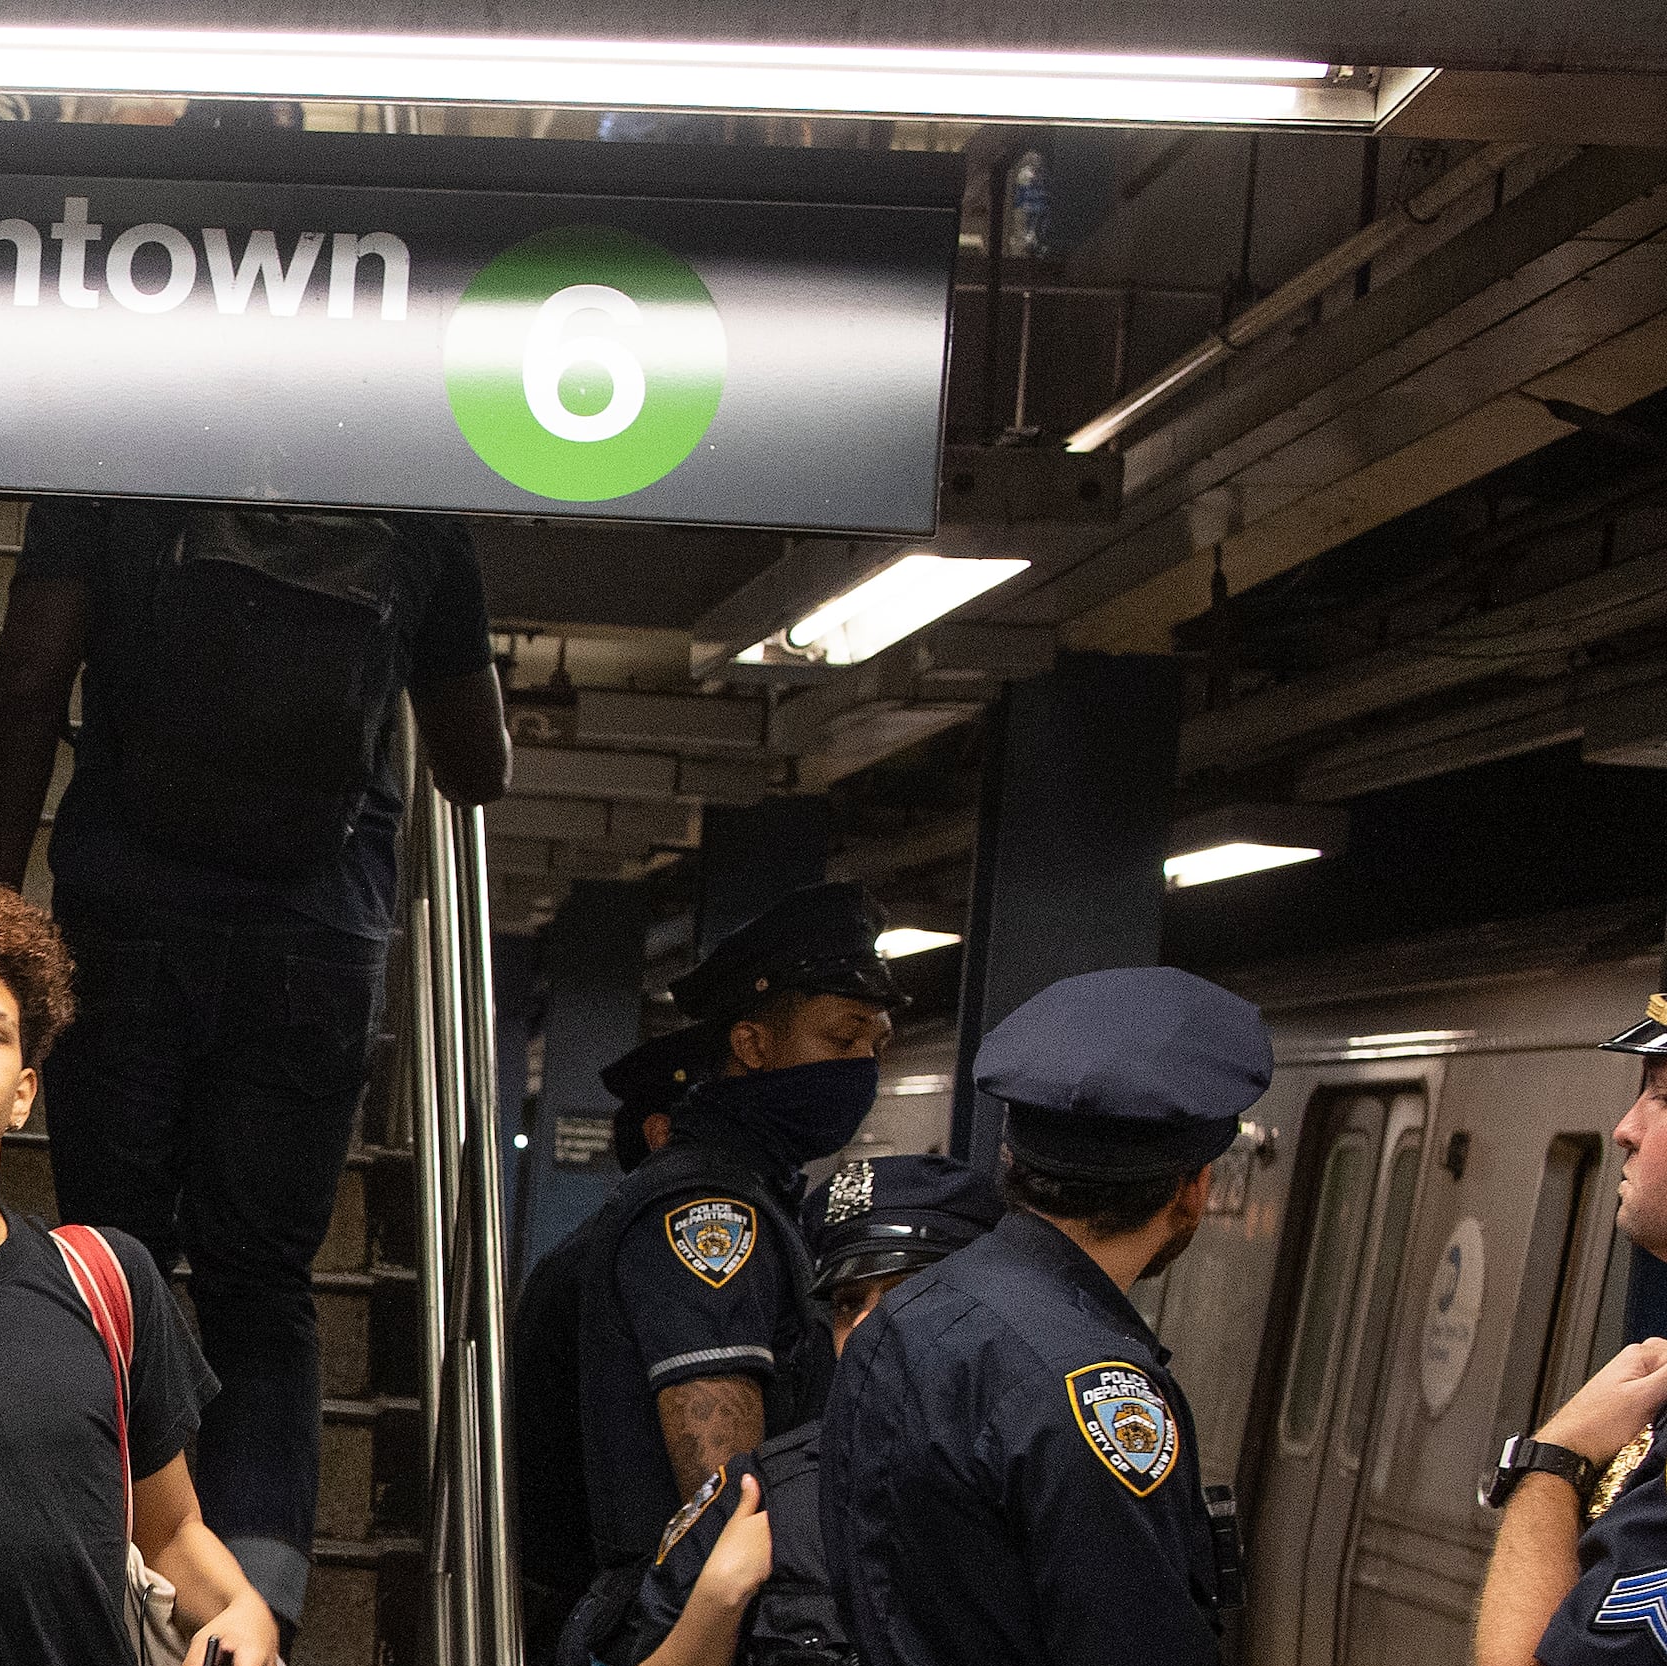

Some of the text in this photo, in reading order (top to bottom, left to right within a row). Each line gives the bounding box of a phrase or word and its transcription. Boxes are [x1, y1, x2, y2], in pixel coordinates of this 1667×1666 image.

[521, 283, 646, 444] 6
[674, 1211, 749, 1232] DEPARTMENT
[688, 1203, 733, 1217] POLICE
[676, 1238, 696, 1260] CITY
[1099, 1370, 1150, 1390] POLICE
[1082, 1384, 1166, 1411] DEPARTMENT
[1086, 1420, 1132, 1473] CITY OF
[1148, 1450, 1172, 1480] NEW
